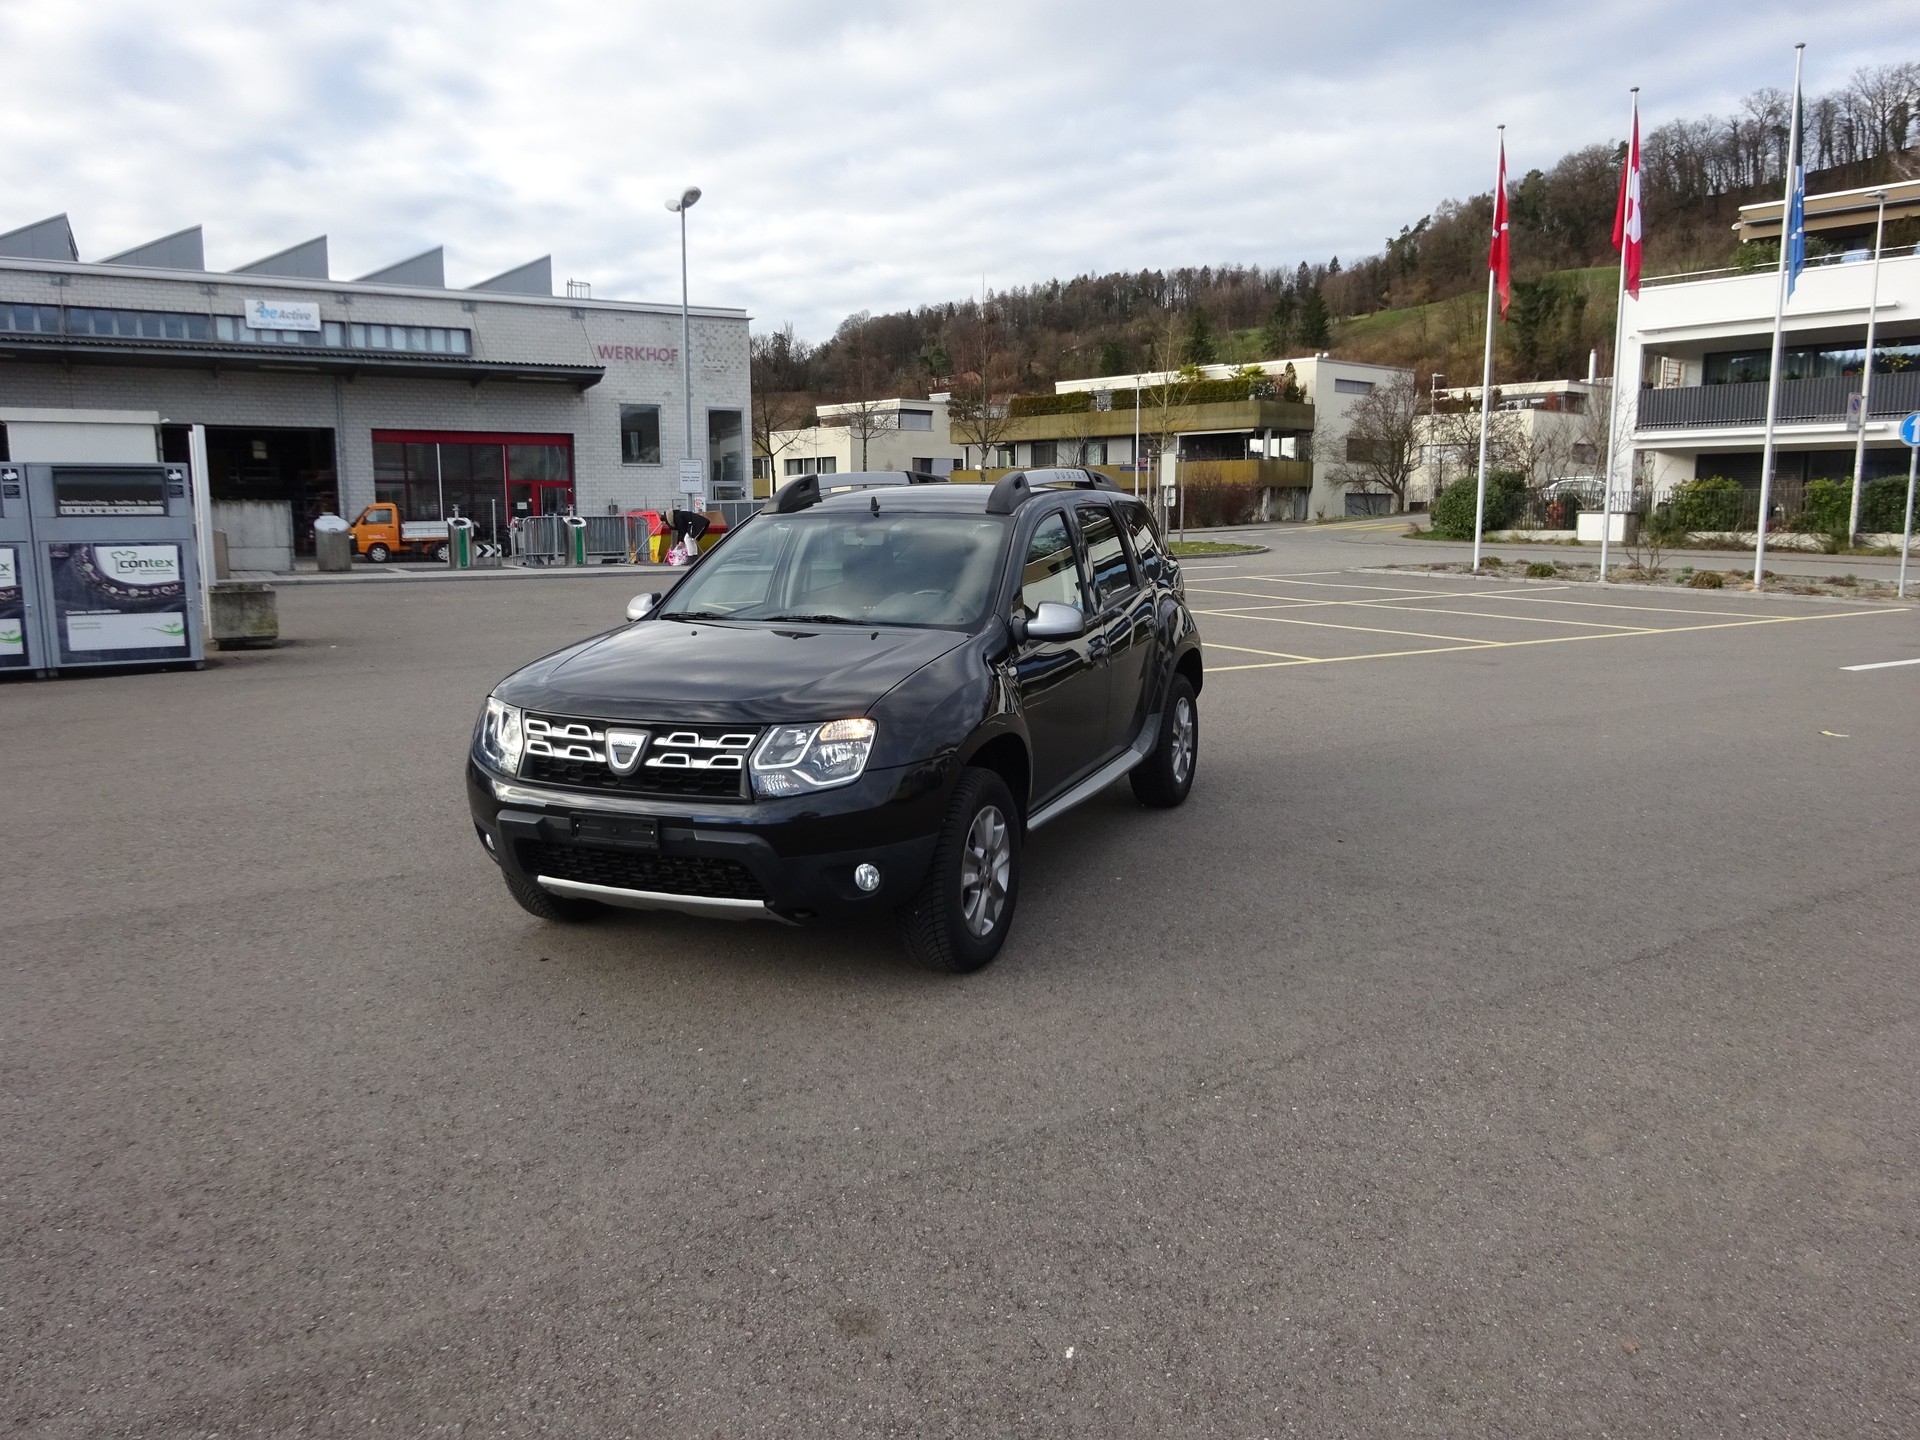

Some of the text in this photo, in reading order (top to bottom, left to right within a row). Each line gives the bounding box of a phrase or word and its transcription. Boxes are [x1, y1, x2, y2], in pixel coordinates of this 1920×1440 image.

[279, 309, 311, 320] Active
[598, 344, 678, 362] WERKHOF
[1054, 471, 1086, 479] DUSTER
[120, 559, 174, 568] contex
